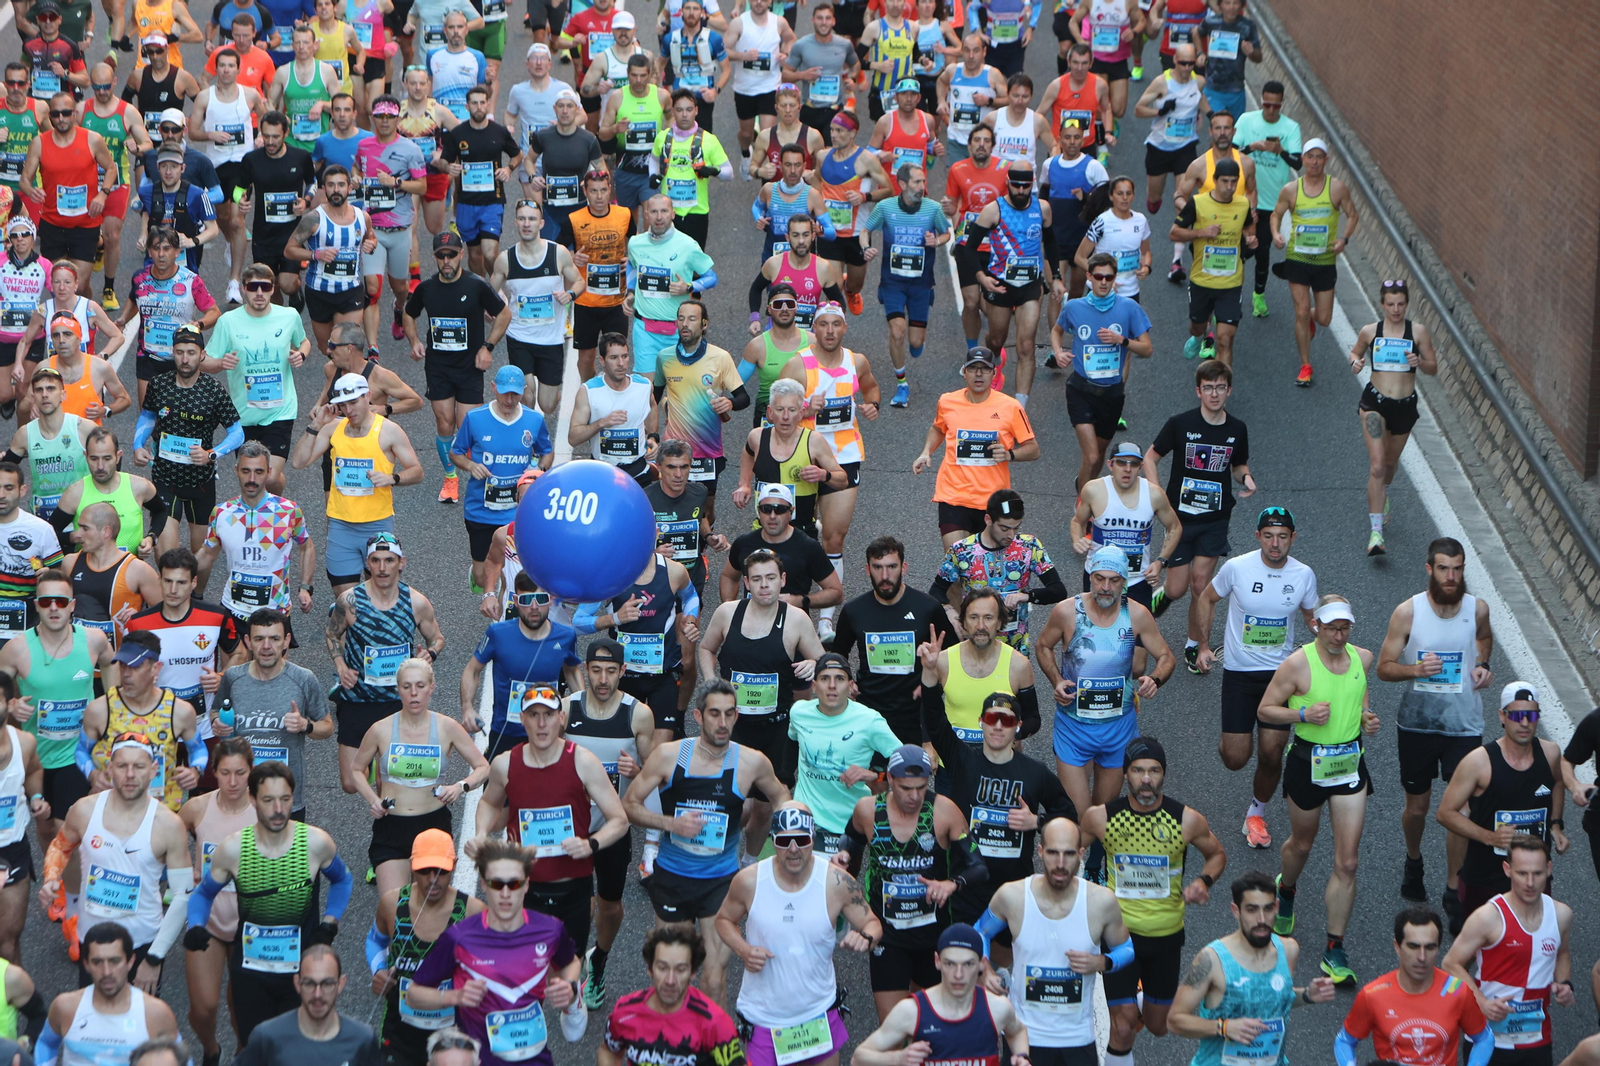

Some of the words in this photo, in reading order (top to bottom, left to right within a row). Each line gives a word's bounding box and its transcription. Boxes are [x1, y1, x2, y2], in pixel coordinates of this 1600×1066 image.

[591, 233, 618, 242] GALBIS
[648, 266, 667, 275] ZURICH
[3, 276, 39, 287] ENTRENA
[796, 305, 814, 313] URICH
[155, 323, 179, 331] ZURICH
[170, 447, 187, 455] BEBETO
[495, 454, 529, 464] BETANO
[1197, 482, 1217, 490] ZURICH
[543, 488, 598, 525] 3:00
[672, 523, 693, 531] ZURICH
[1102, 530, 1139, 539] WESTBURY
[244, 576, 268, 584] ZURICH
[1259, 618, 1284, 626] ZURICH
[84, 623, 108, 631] ZURICH
[882, 634, 909, 643] ZURICH
[381, 647, 405, 656] ZURICH
[1094, 680, 1120, 688] ZURICH
[174, 687, 200, 697] ZURICH
[1094, 694, 1109, 702] 3251
[56, 702, 83, 710] ZURICH
[1089, 701, 1114, 710] MÁRQUEZ
[408, 747, 434, 755] ZURICH
[1330, 746, 1353, 755] ZURICH
[976, 775, 1024, 807] UCLA
[536, 811, 564, 820] ZURICH
[1514, 813, 1541, 821] ZURICH
[537, 827, 554, 836] 4033
[989, 829, 1005, 837] 2424
[690, 838, 704, 846] DANI
[979, 838, 1012, 847] FRANCESCO
[1133, 857, 1162, 866] ZURICH
[105, 873, 135, 886] ZURICH
[277, 881, 306, 893] SCOTT
[104, 898, 133, 910] SEBASTIA
[262, 929, 293, 937] ZURICH
[1045, 970, 1075, 978] ZURICH
[1044, 985, 1063, 993] 2408
[1040, 995, 1068, 1003] LAURENT
[413, 1010, 442, 1018] EMANUEL
[509, 1009, 536, 1023] ZURICH
[793, 1029, 809, 1038] 2131
[788, 1042, 802, 1050] IVAN
[803, 1037, 820, 1048] TIZÓN
[627, 1047, 697, 1066] RUNNERS
